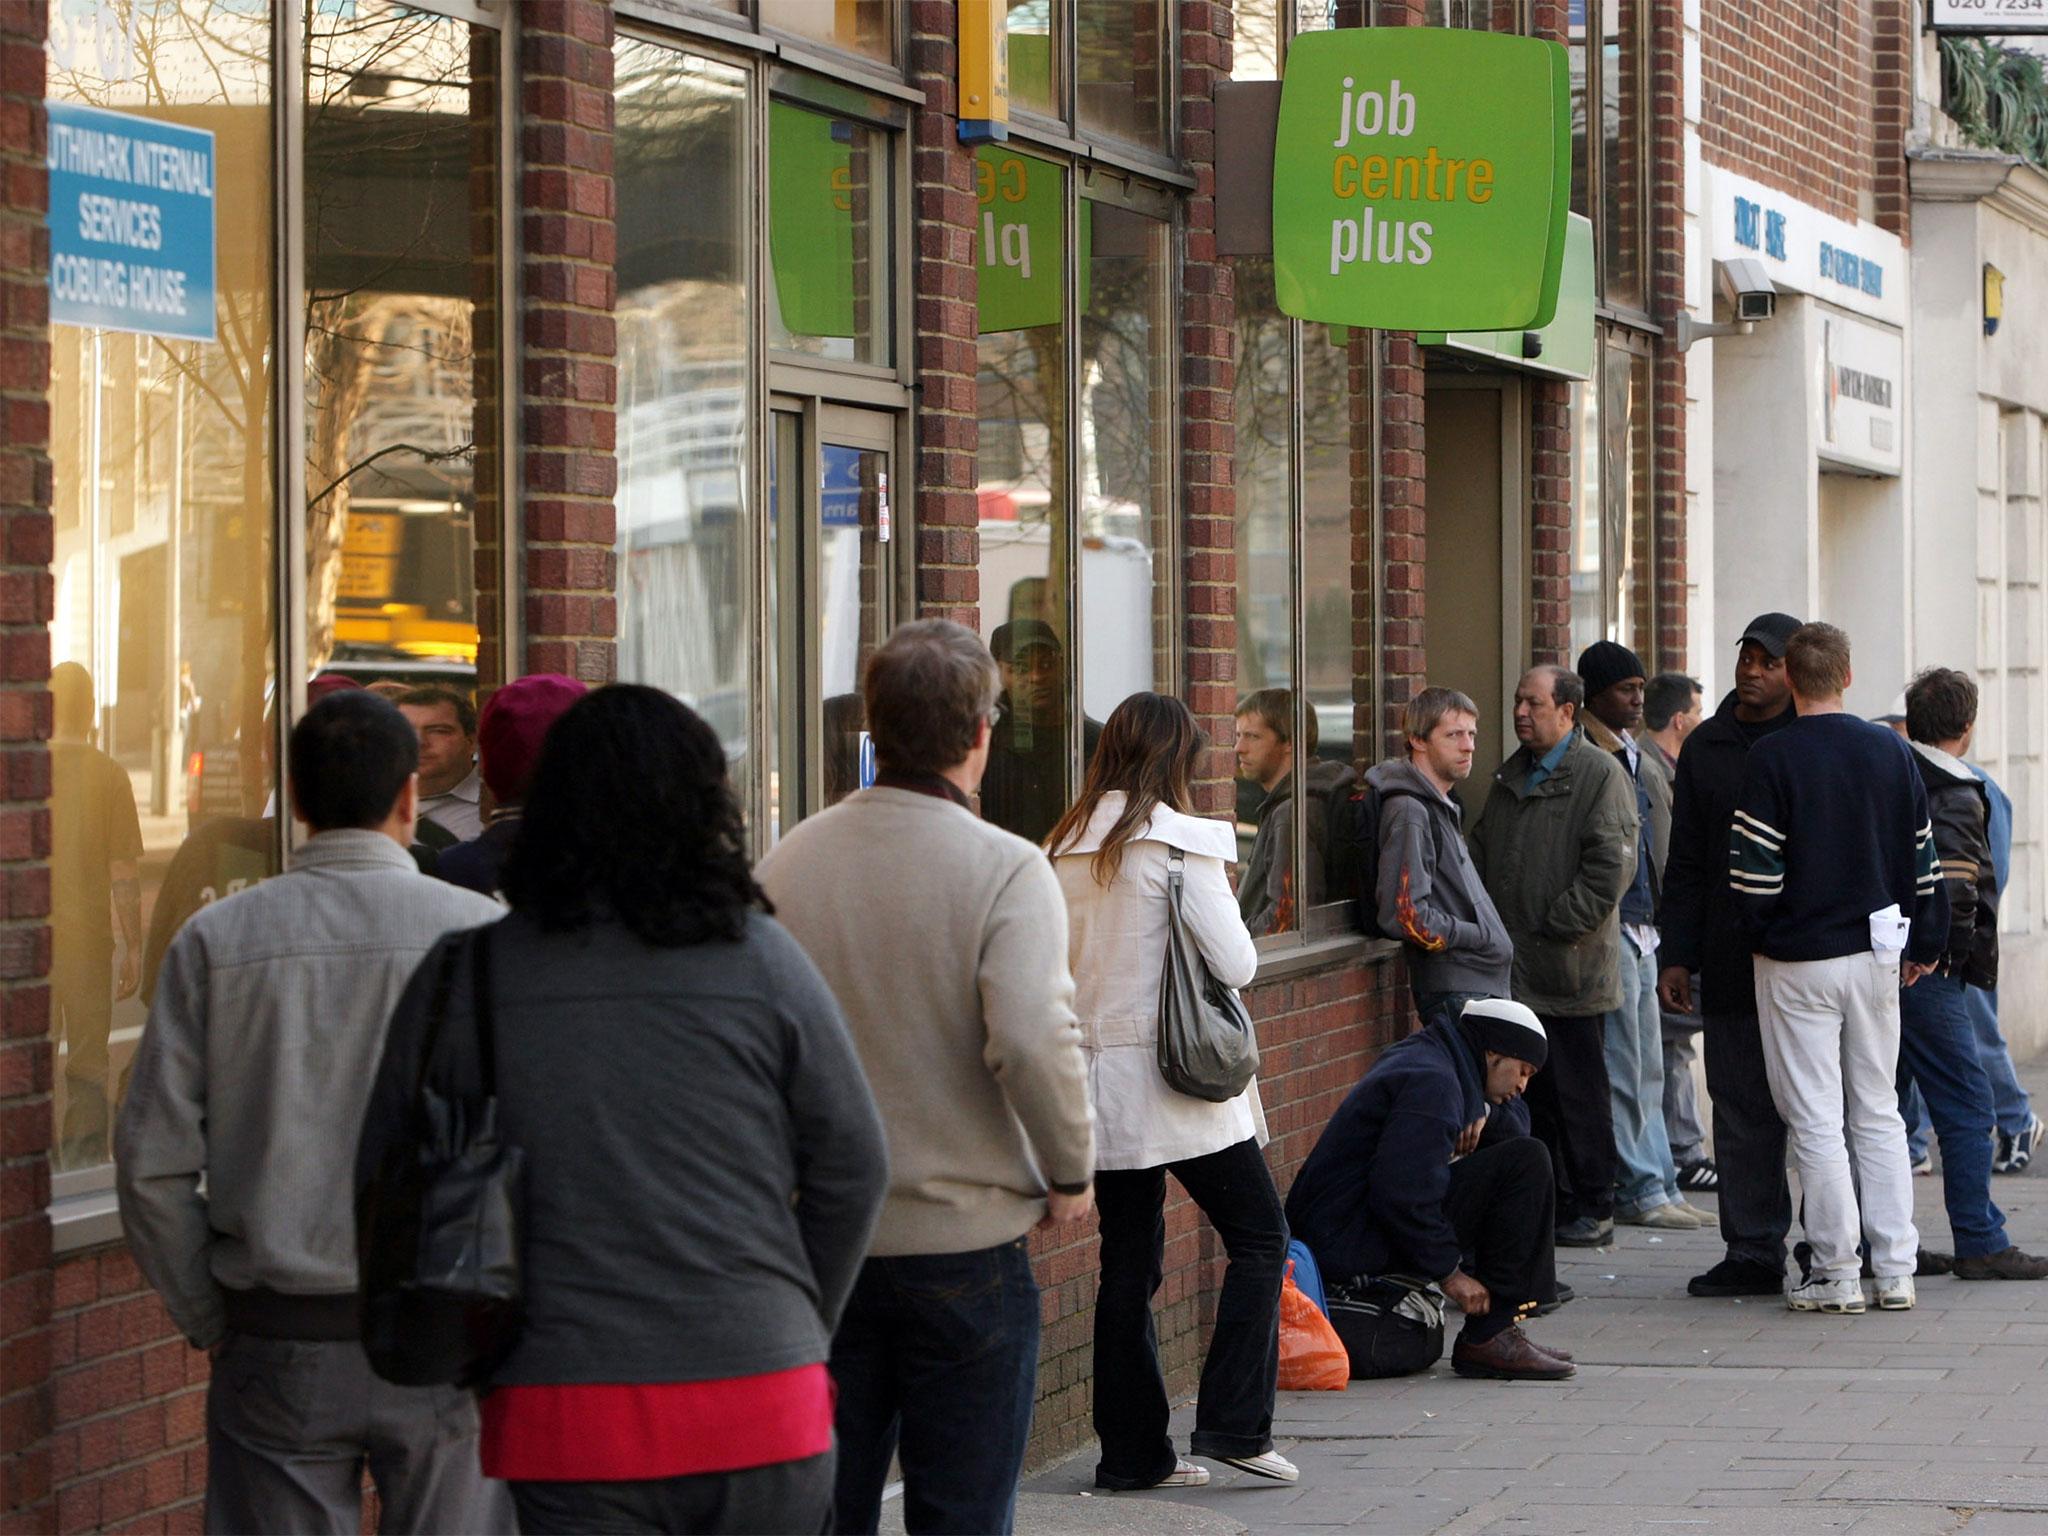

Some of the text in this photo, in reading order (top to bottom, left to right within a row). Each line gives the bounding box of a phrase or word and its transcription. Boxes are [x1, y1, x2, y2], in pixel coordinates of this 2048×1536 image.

[1333, 76, 1417, 147] job
[133, 139, 212, 197] INTERNAL
[1333, 147, 1494, 204] centre
[79, 192, 162, 250] SERVICES
[1330, 207, 1433, 275] plus
[52, 252, 187, 316] COBURG HOUSE
